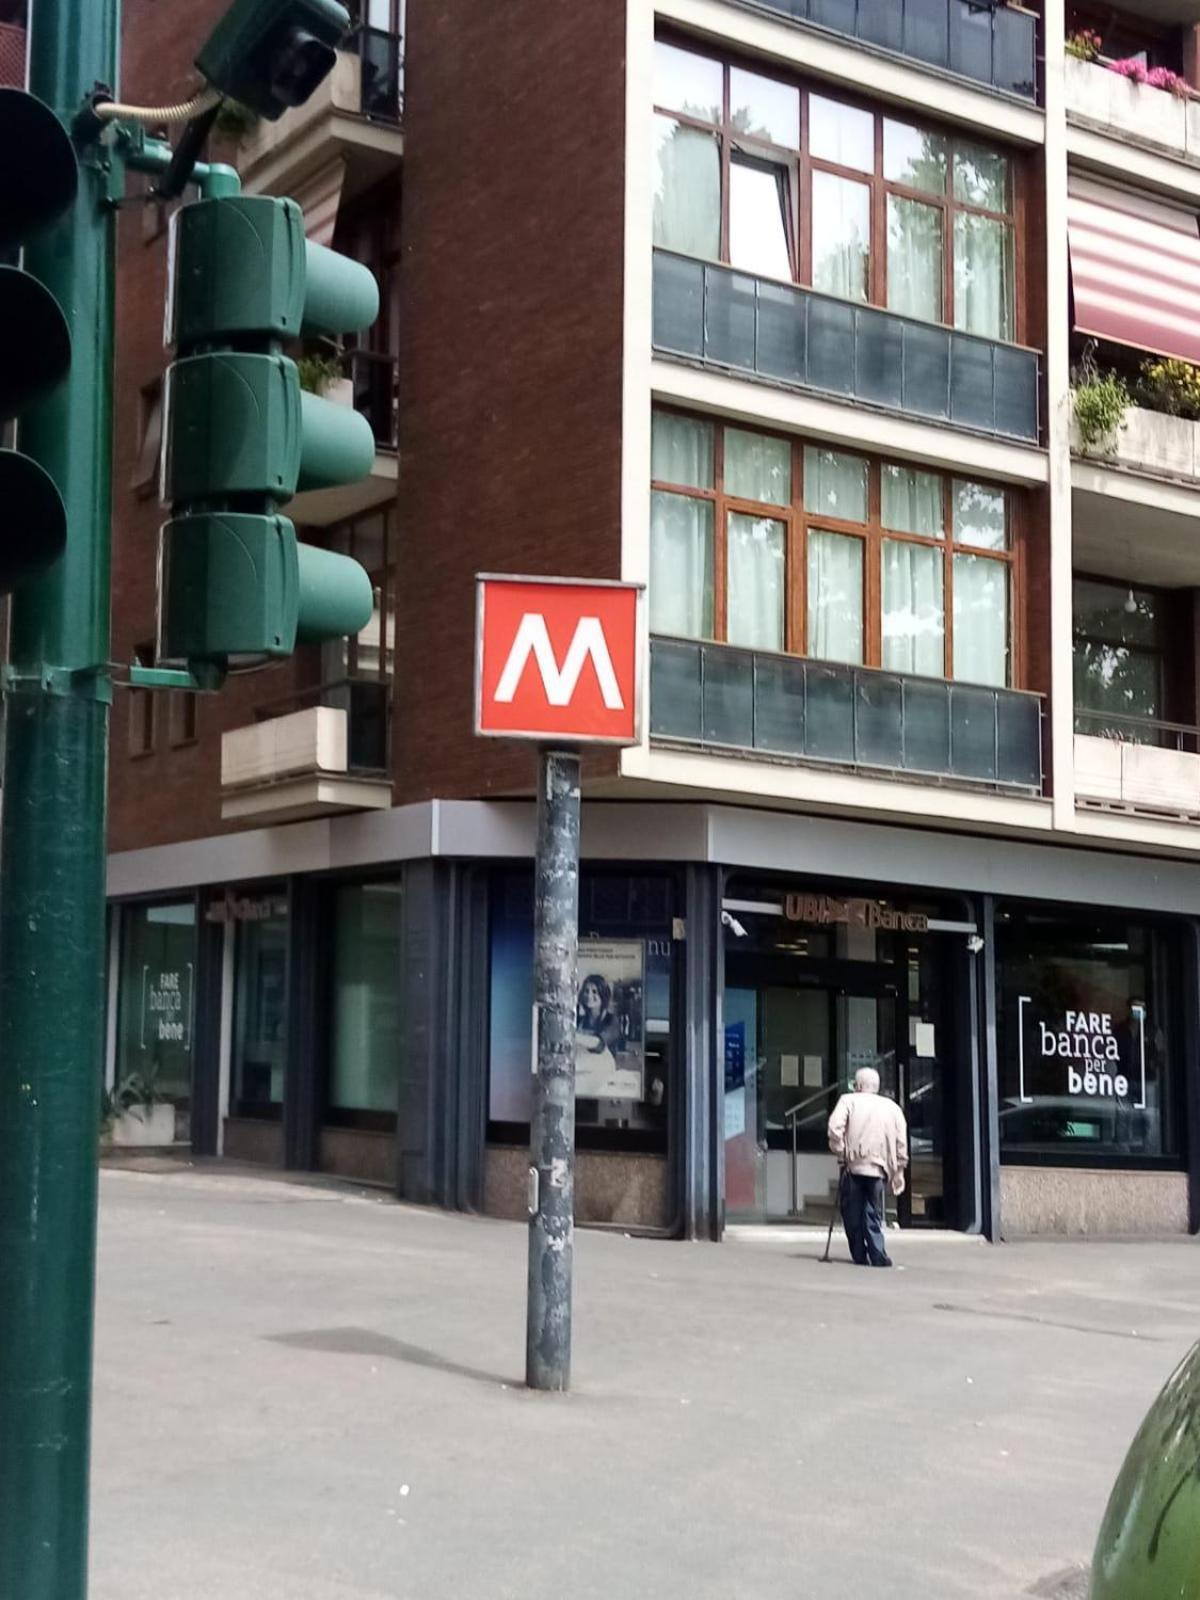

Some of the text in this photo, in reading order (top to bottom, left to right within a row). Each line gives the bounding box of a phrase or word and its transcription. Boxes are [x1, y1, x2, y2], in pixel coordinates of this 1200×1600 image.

[493, 612, 625, 710] M
[870, 902, 929, 933] Banca
[160, 973, 179, 990] FARE
[150, 984, 181, 1010] banca
[158, 1018, 184, 1040] bene
[1066, 1010, 1112, 1034] FARE
[1039, 1021, 1120, 1060] banca
[1085, 1058, 1106, 1077] per
[1068, 1066, 1129, 1097] bene
